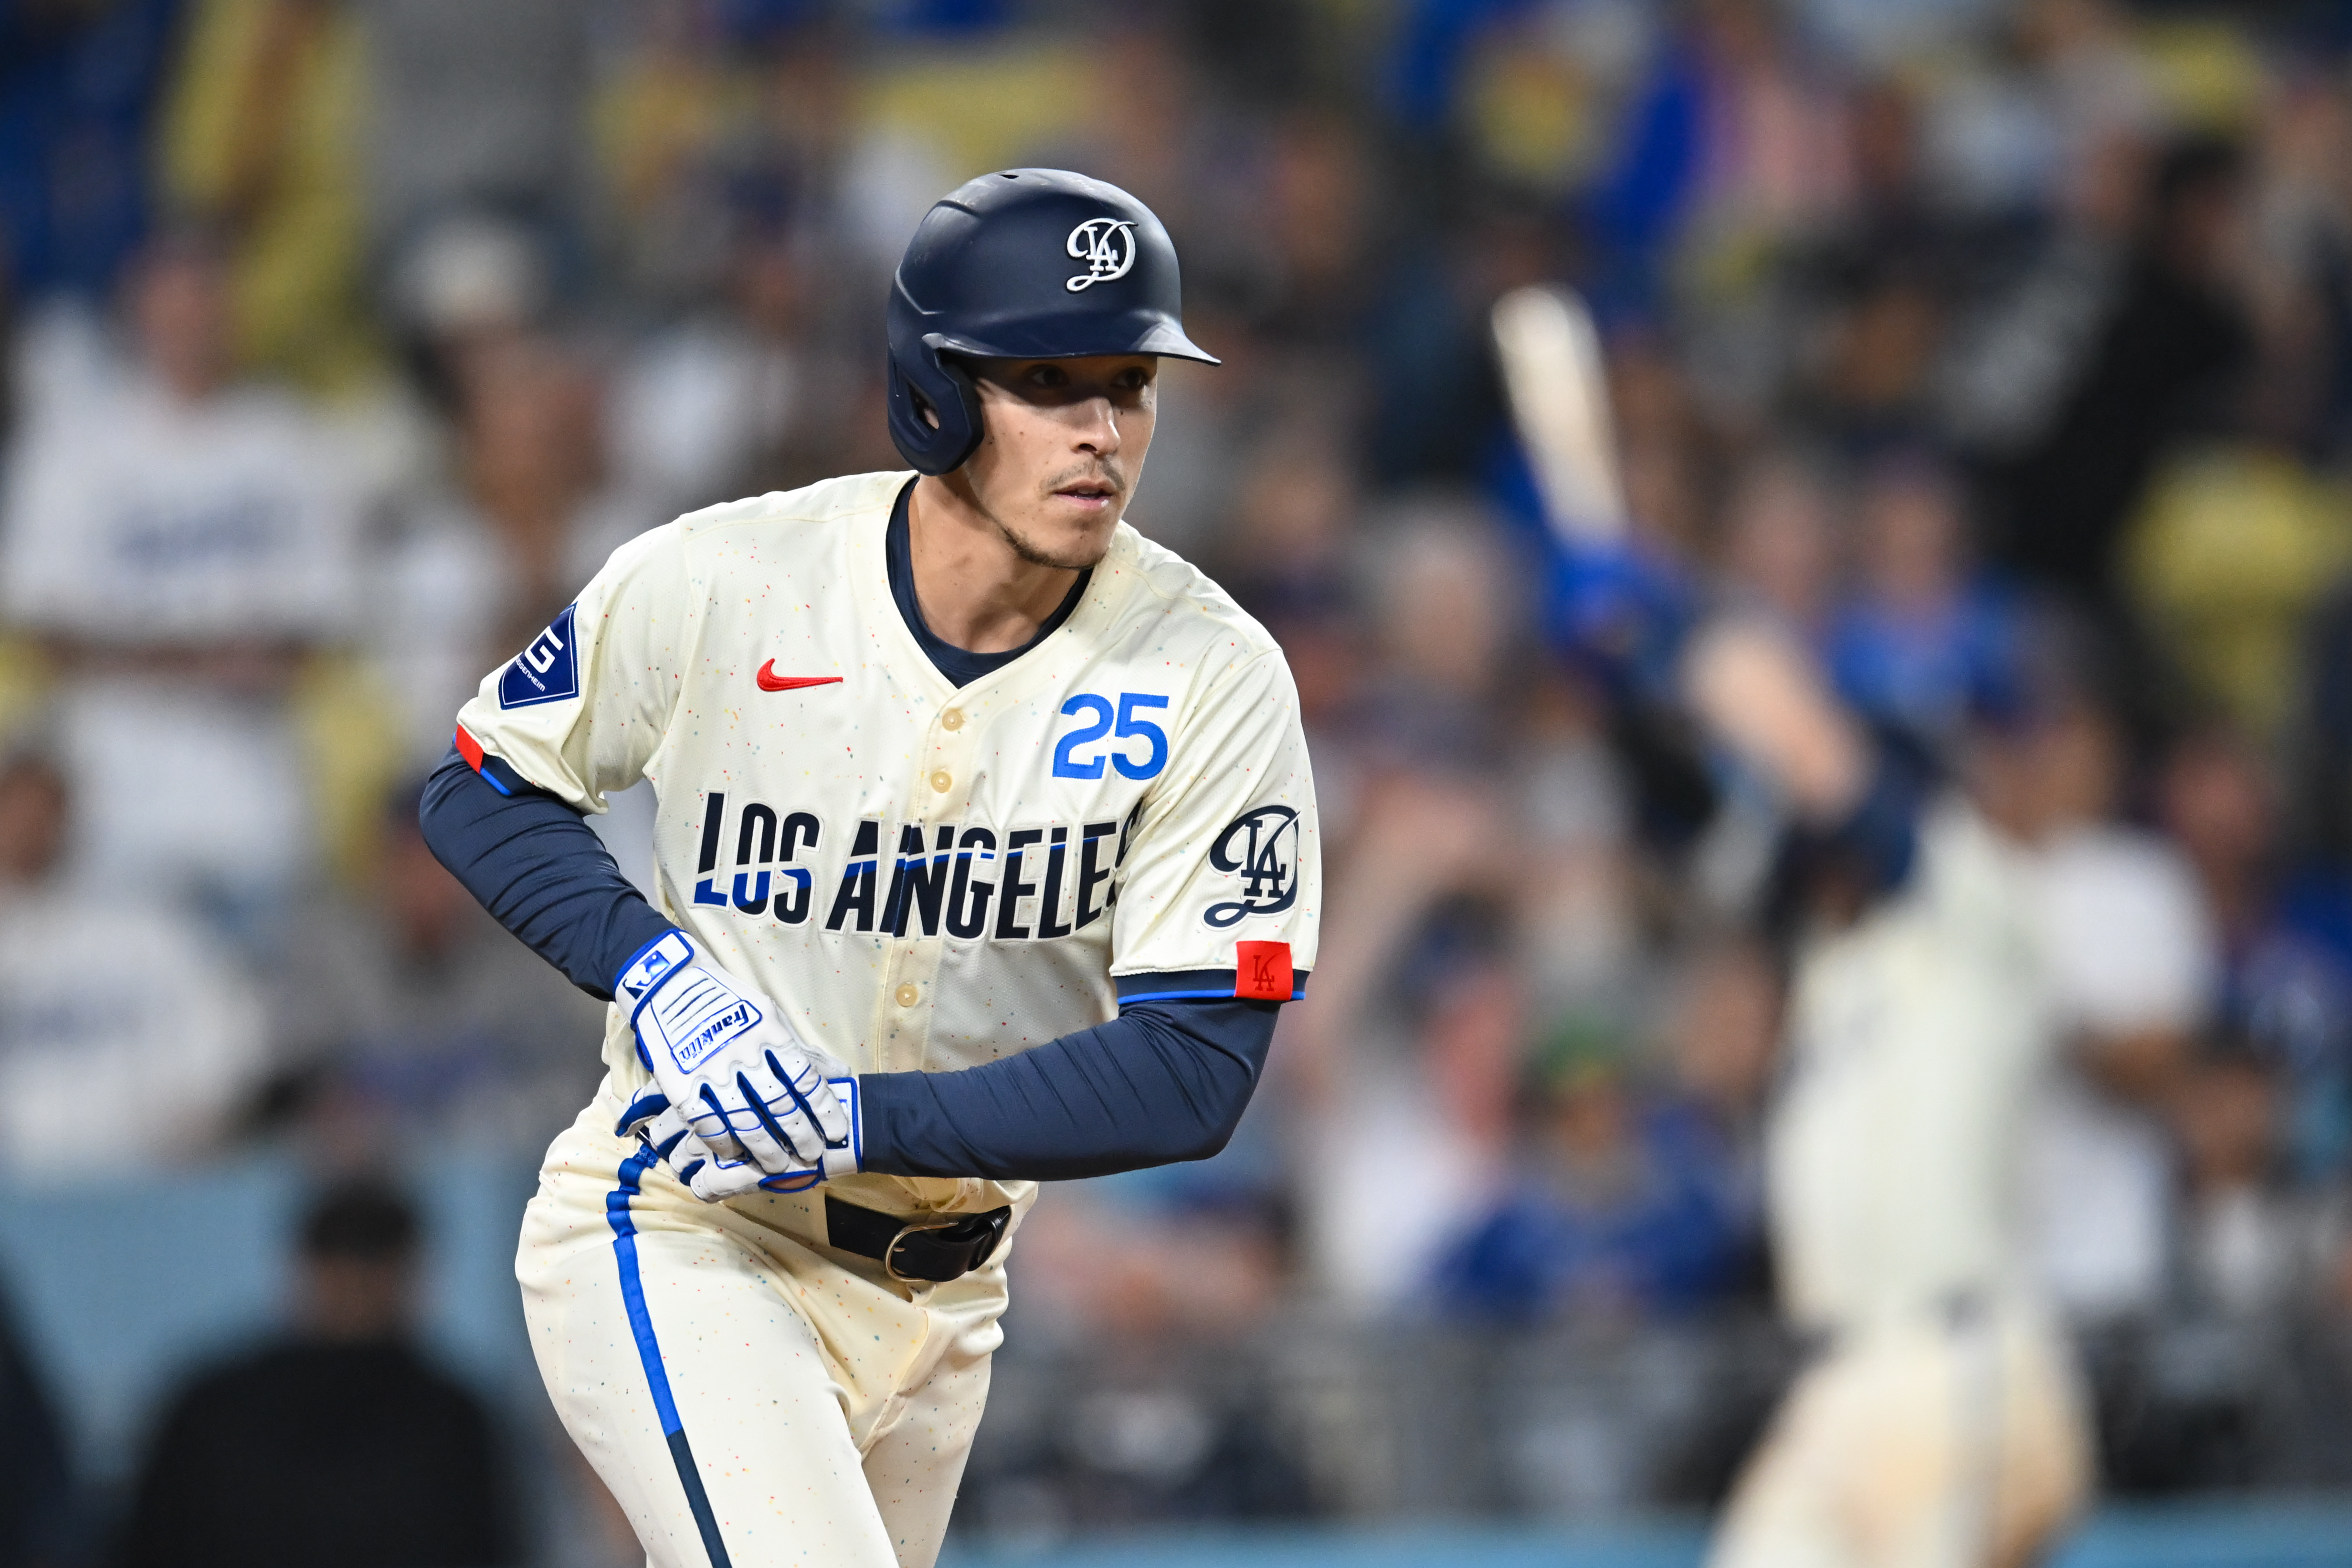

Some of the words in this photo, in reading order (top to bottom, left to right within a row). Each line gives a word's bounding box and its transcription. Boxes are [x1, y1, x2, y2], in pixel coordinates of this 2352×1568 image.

[525, 625, 564, 673] G
[1052, 693, 1169, 780] 25
[693, 792, 820, 925] LOS
